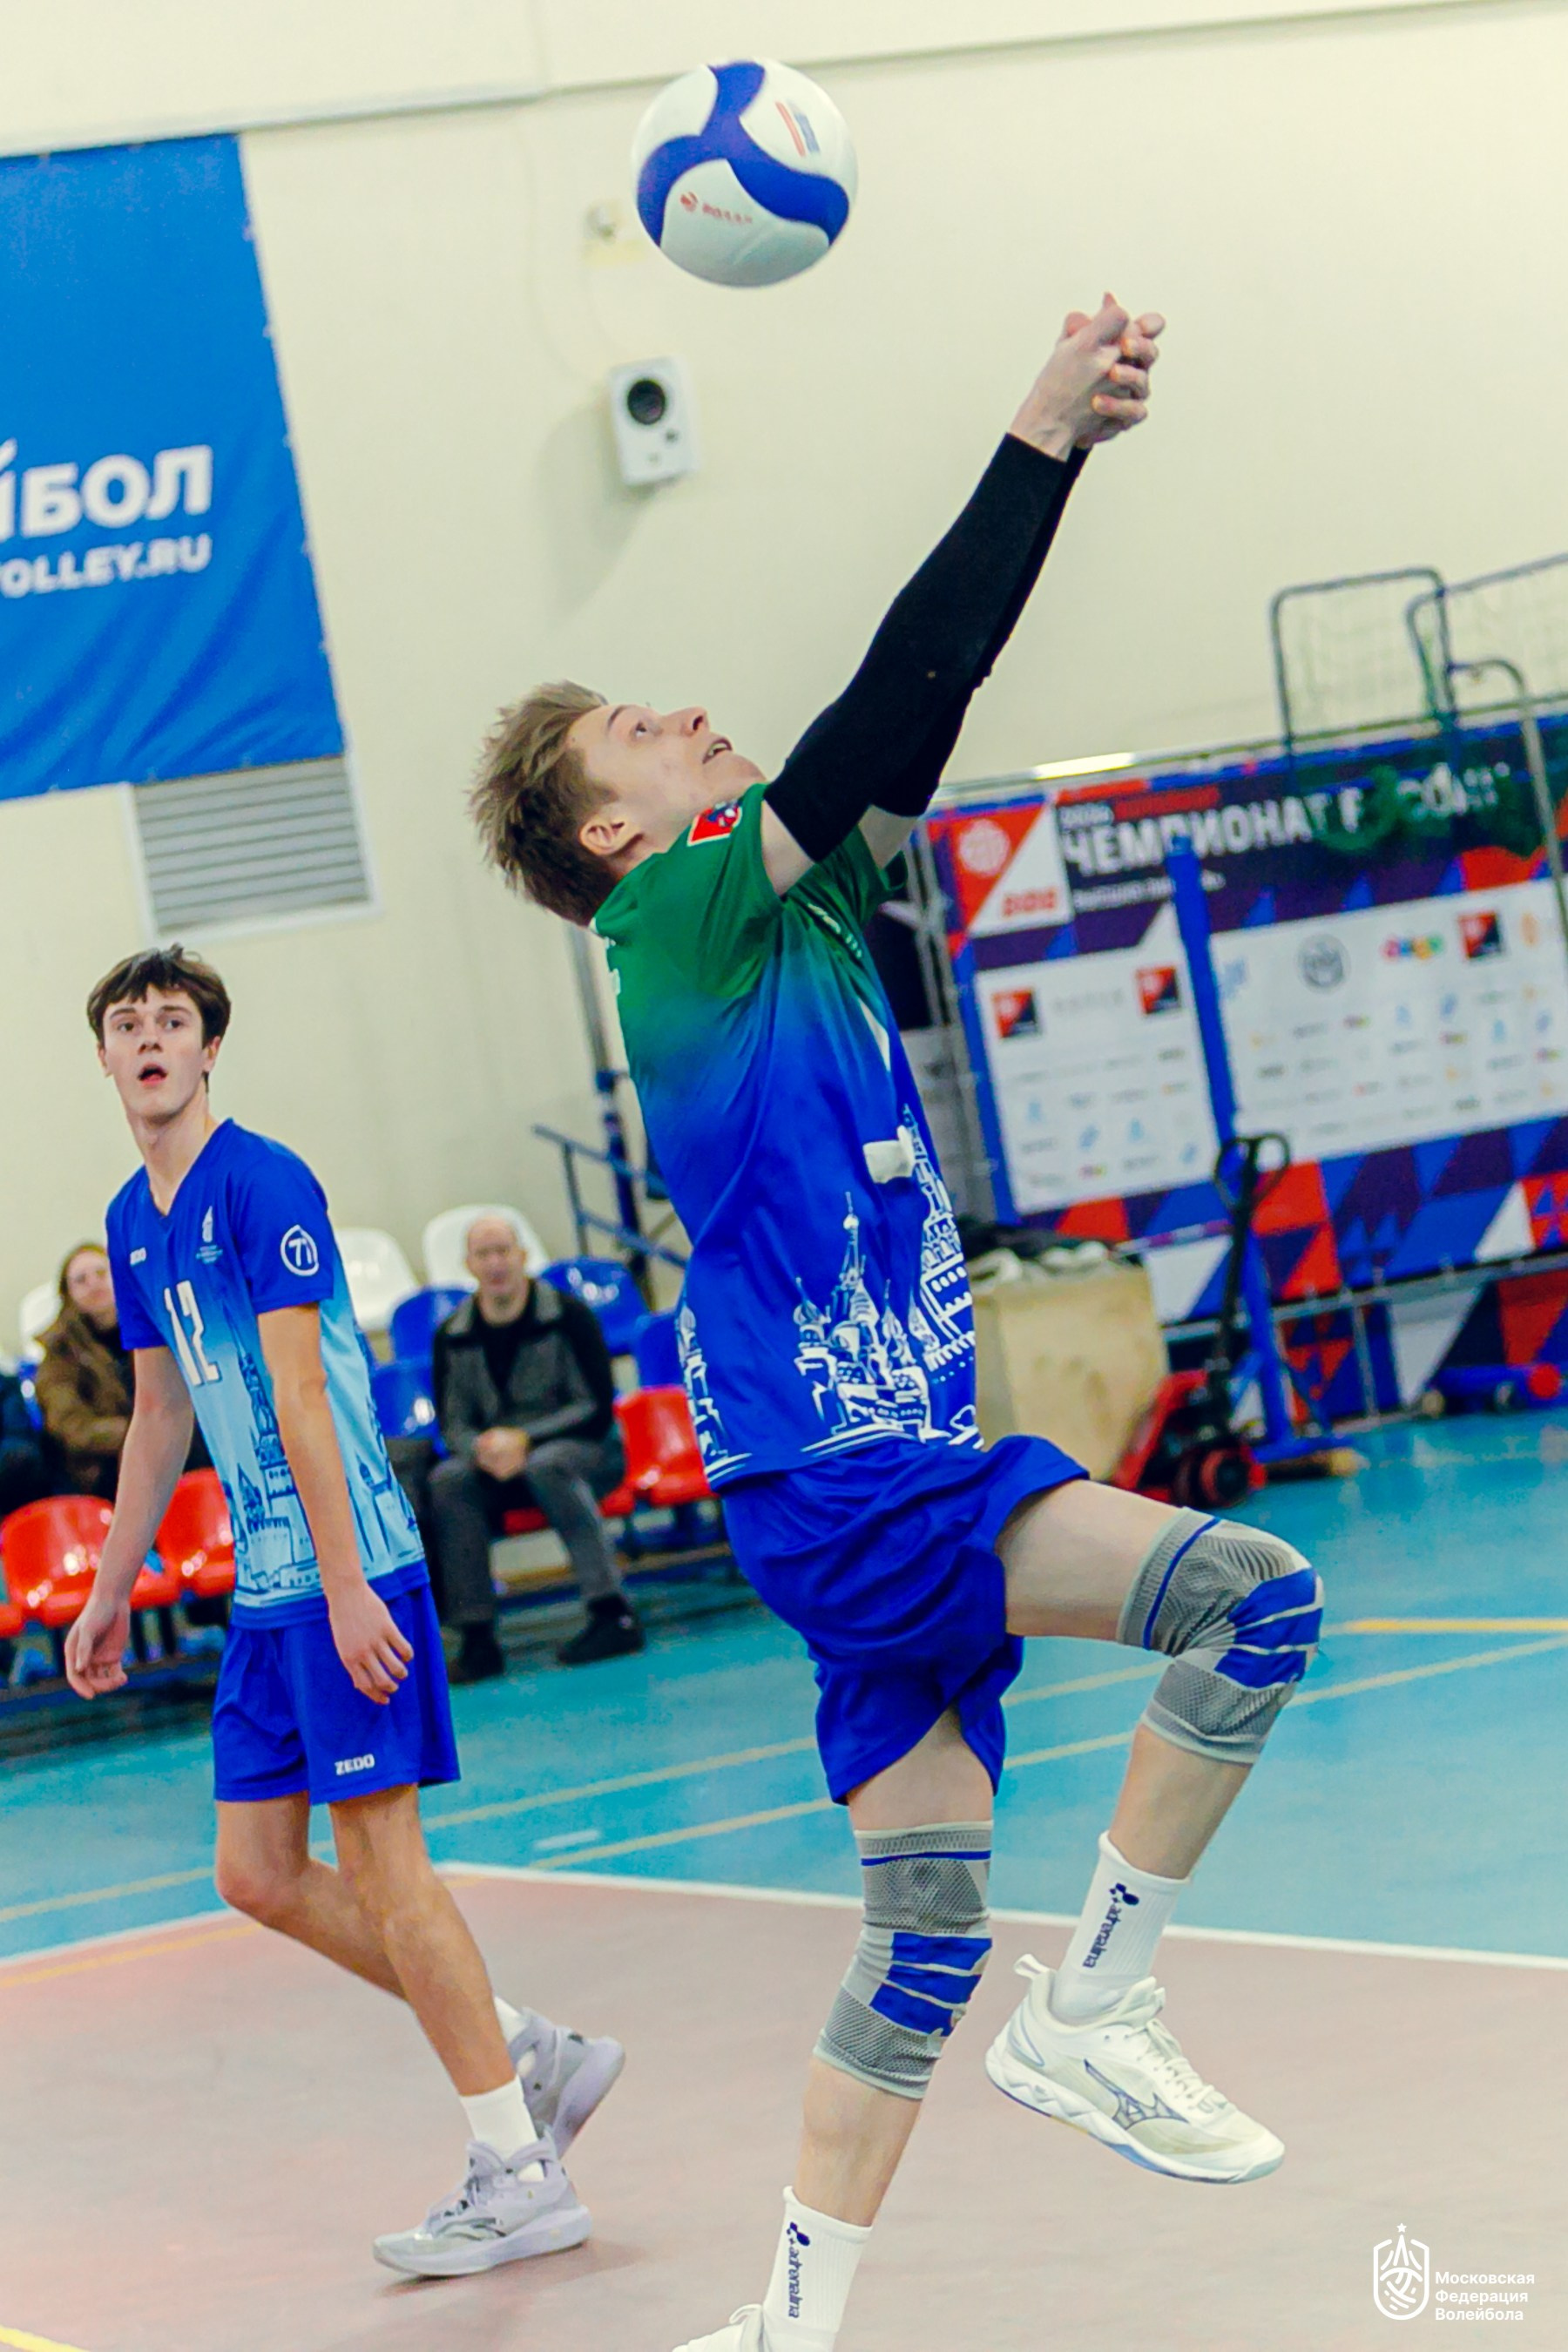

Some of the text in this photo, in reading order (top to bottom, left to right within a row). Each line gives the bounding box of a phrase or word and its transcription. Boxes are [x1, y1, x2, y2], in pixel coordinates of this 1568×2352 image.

[0, 437, 213, 544] БОЛ
[164, 1280, 220, 1386] 12
[335, 1754, 375, 1775] ZEDO
